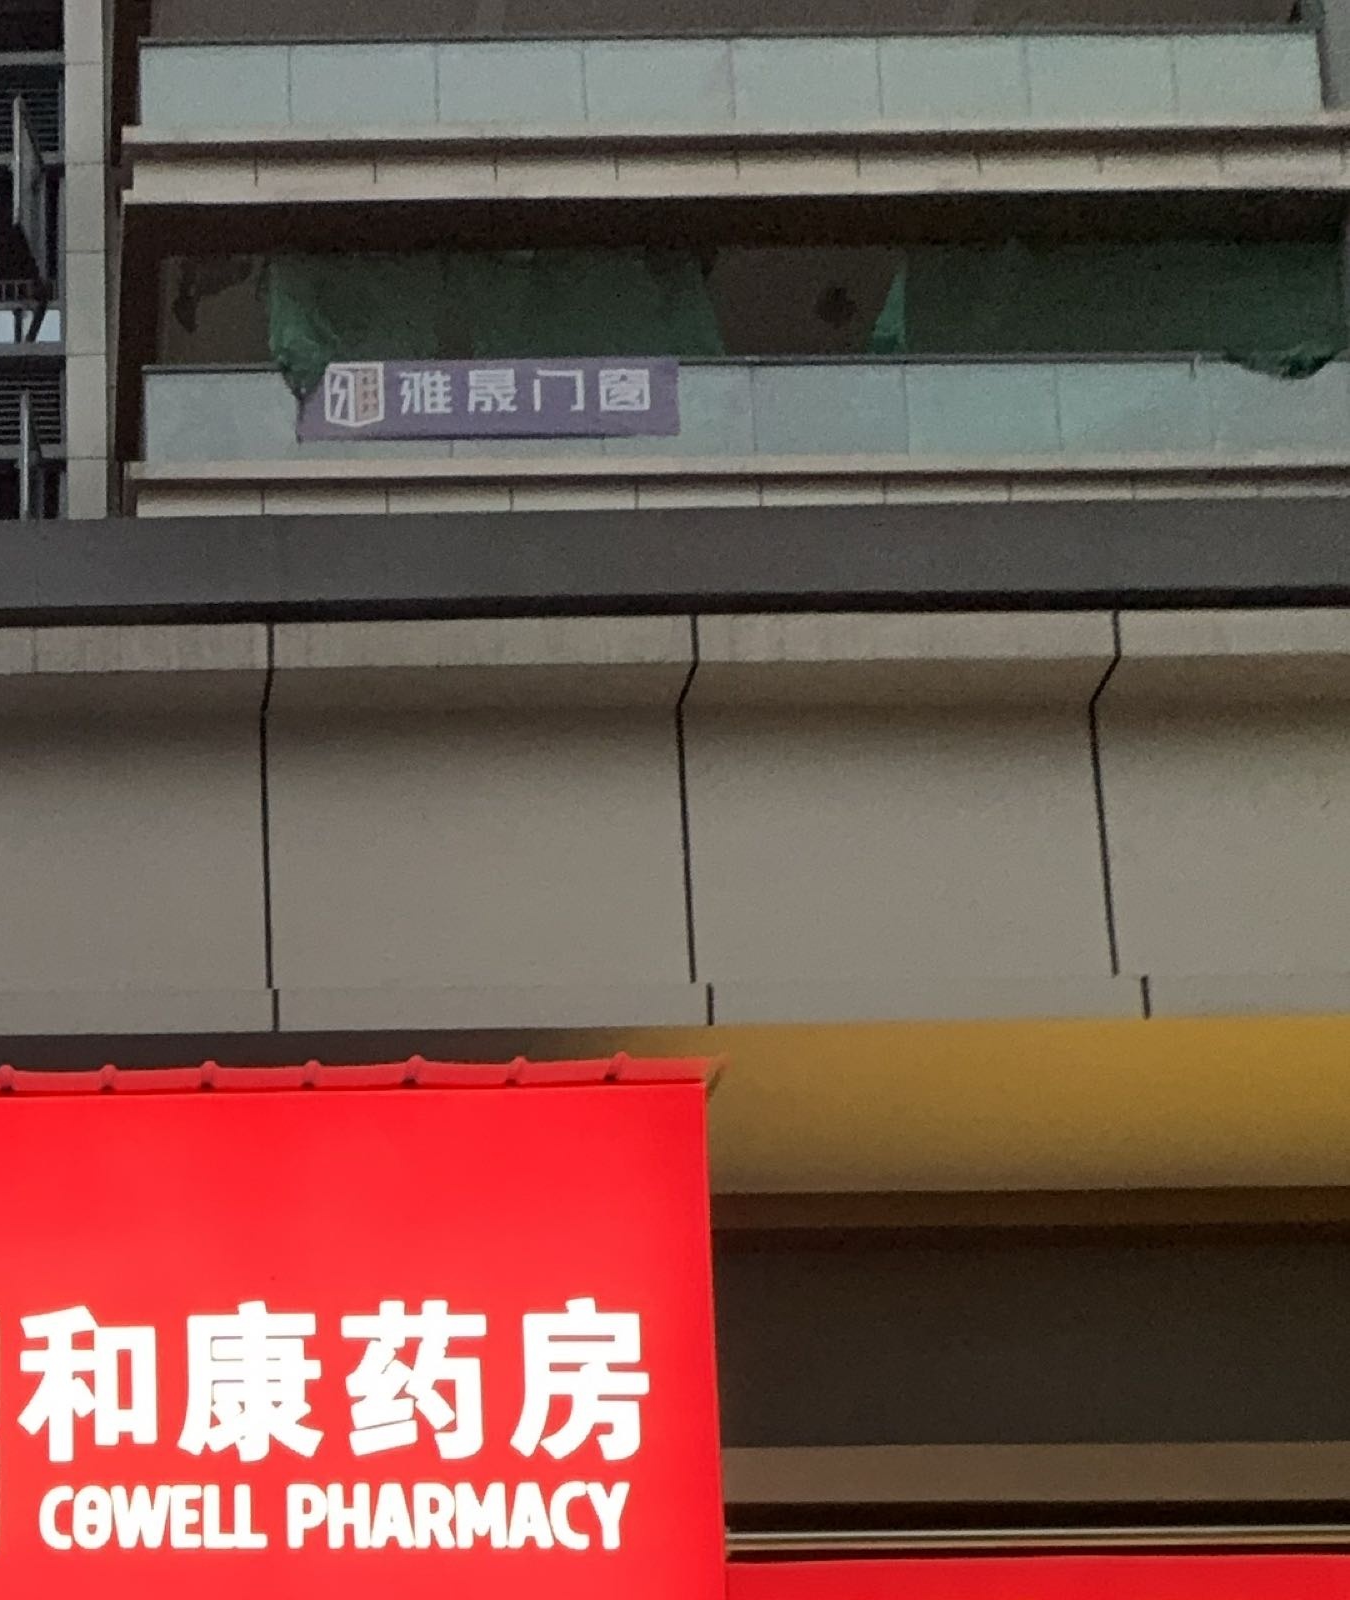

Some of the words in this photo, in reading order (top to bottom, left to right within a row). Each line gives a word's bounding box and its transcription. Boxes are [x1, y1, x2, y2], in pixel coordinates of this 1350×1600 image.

[399, 367, 651, 415] 雅晟门窗
[17, 1297, 649, 1462] 和康药房
[39, 1484, 268, 1550] COWELL
[287, 1480, 630, 1551] PHARMACY
